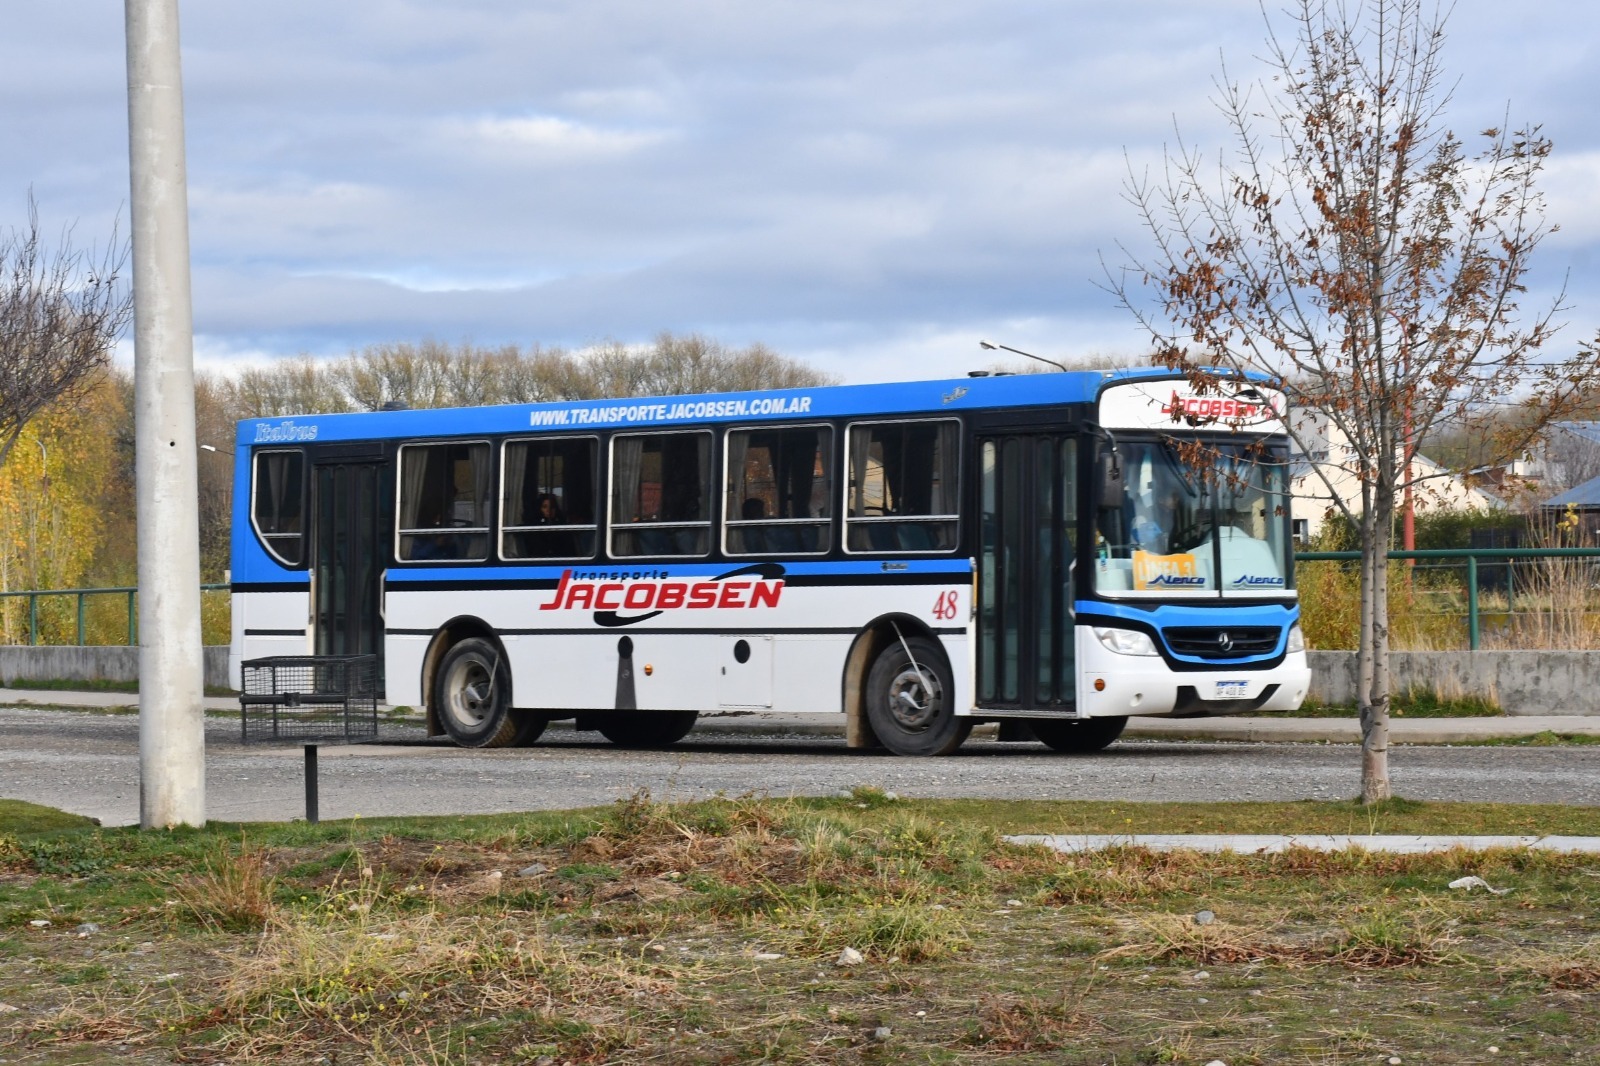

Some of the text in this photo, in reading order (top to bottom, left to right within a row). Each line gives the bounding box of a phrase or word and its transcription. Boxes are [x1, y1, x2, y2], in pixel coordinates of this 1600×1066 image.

[254, 421, 318, 442] Italbus
[572, 570, 669, 583] transporte
[1147, 574, 1206, 585] Alenco
[1232, 574, 1285, 585] Alenco
[538, 569, 785, 611] JACOBSEN
[932, 589, 958, 620] 48
